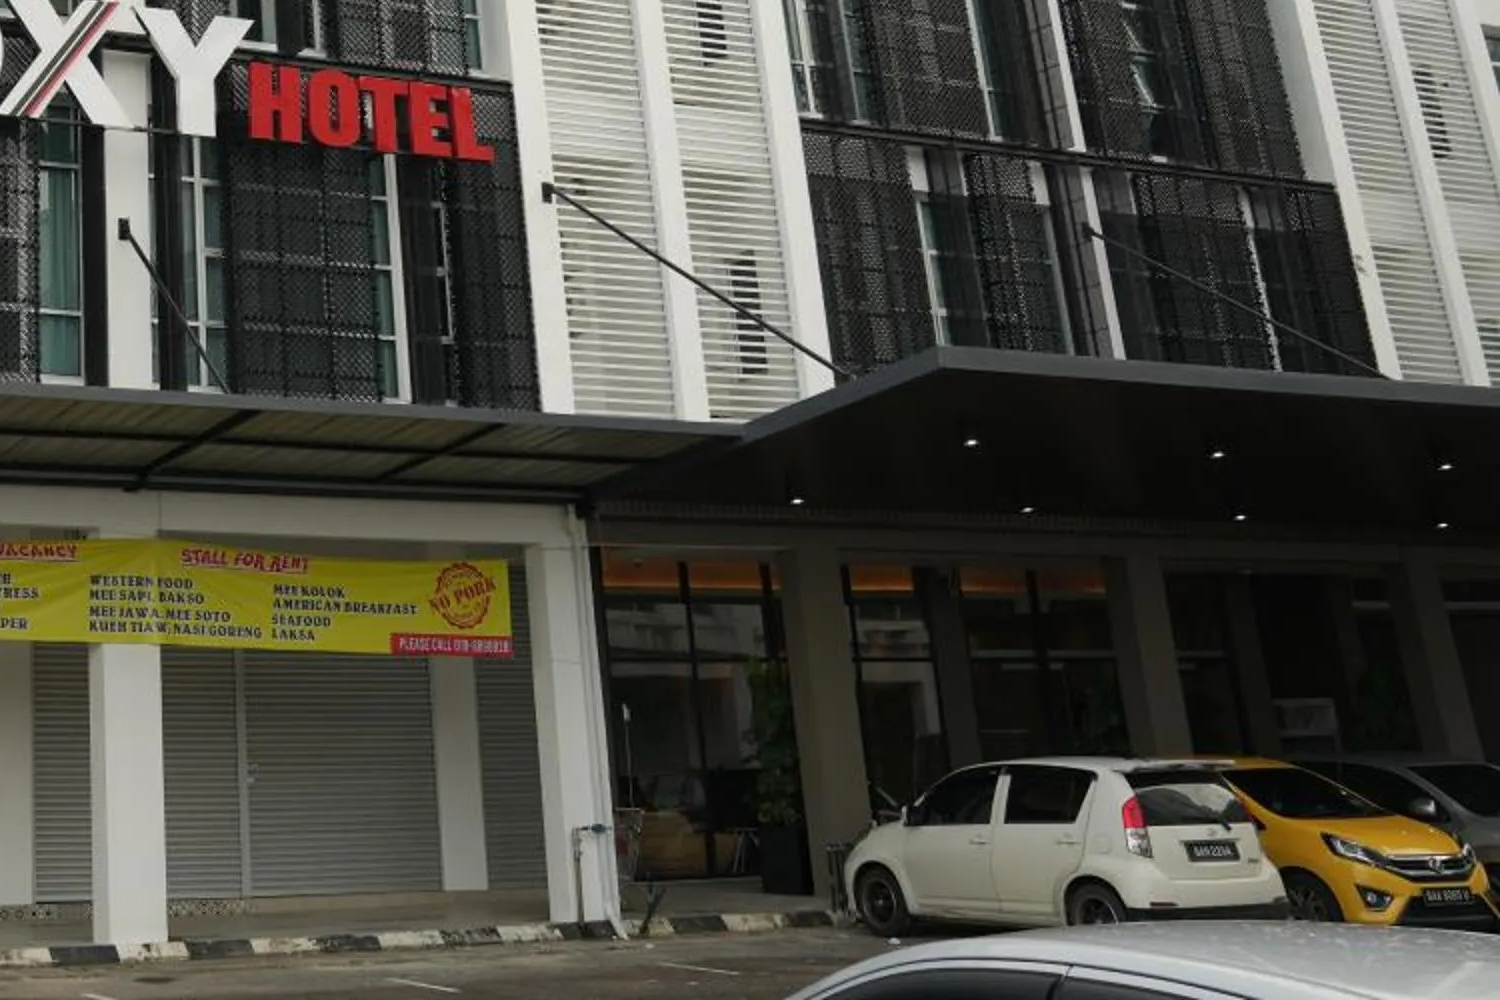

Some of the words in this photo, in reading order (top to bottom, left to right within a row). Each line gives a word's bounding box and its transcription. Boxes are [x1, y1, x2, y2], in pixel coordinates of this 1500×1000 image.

[247, 61, 494, 164] HOTEL
[181, 549, 228, 565] STALL
[234, 552, 266, 571] FOR
[270, 555, 309, 573] RENT
[90, 574, 153, 588] WESTERN
[454, 577, 497, 605] PORK
[273, 600, 342, 613] AMERICAN
[344, 602, 418, 615] BREAKFAST
[195, 611, 231, 623] SOTO
[271, 614, 332, 627] SEAFOOD
[209, 625, 263, 639] GORENG
[271, 629, 316, 642] LAKSA
